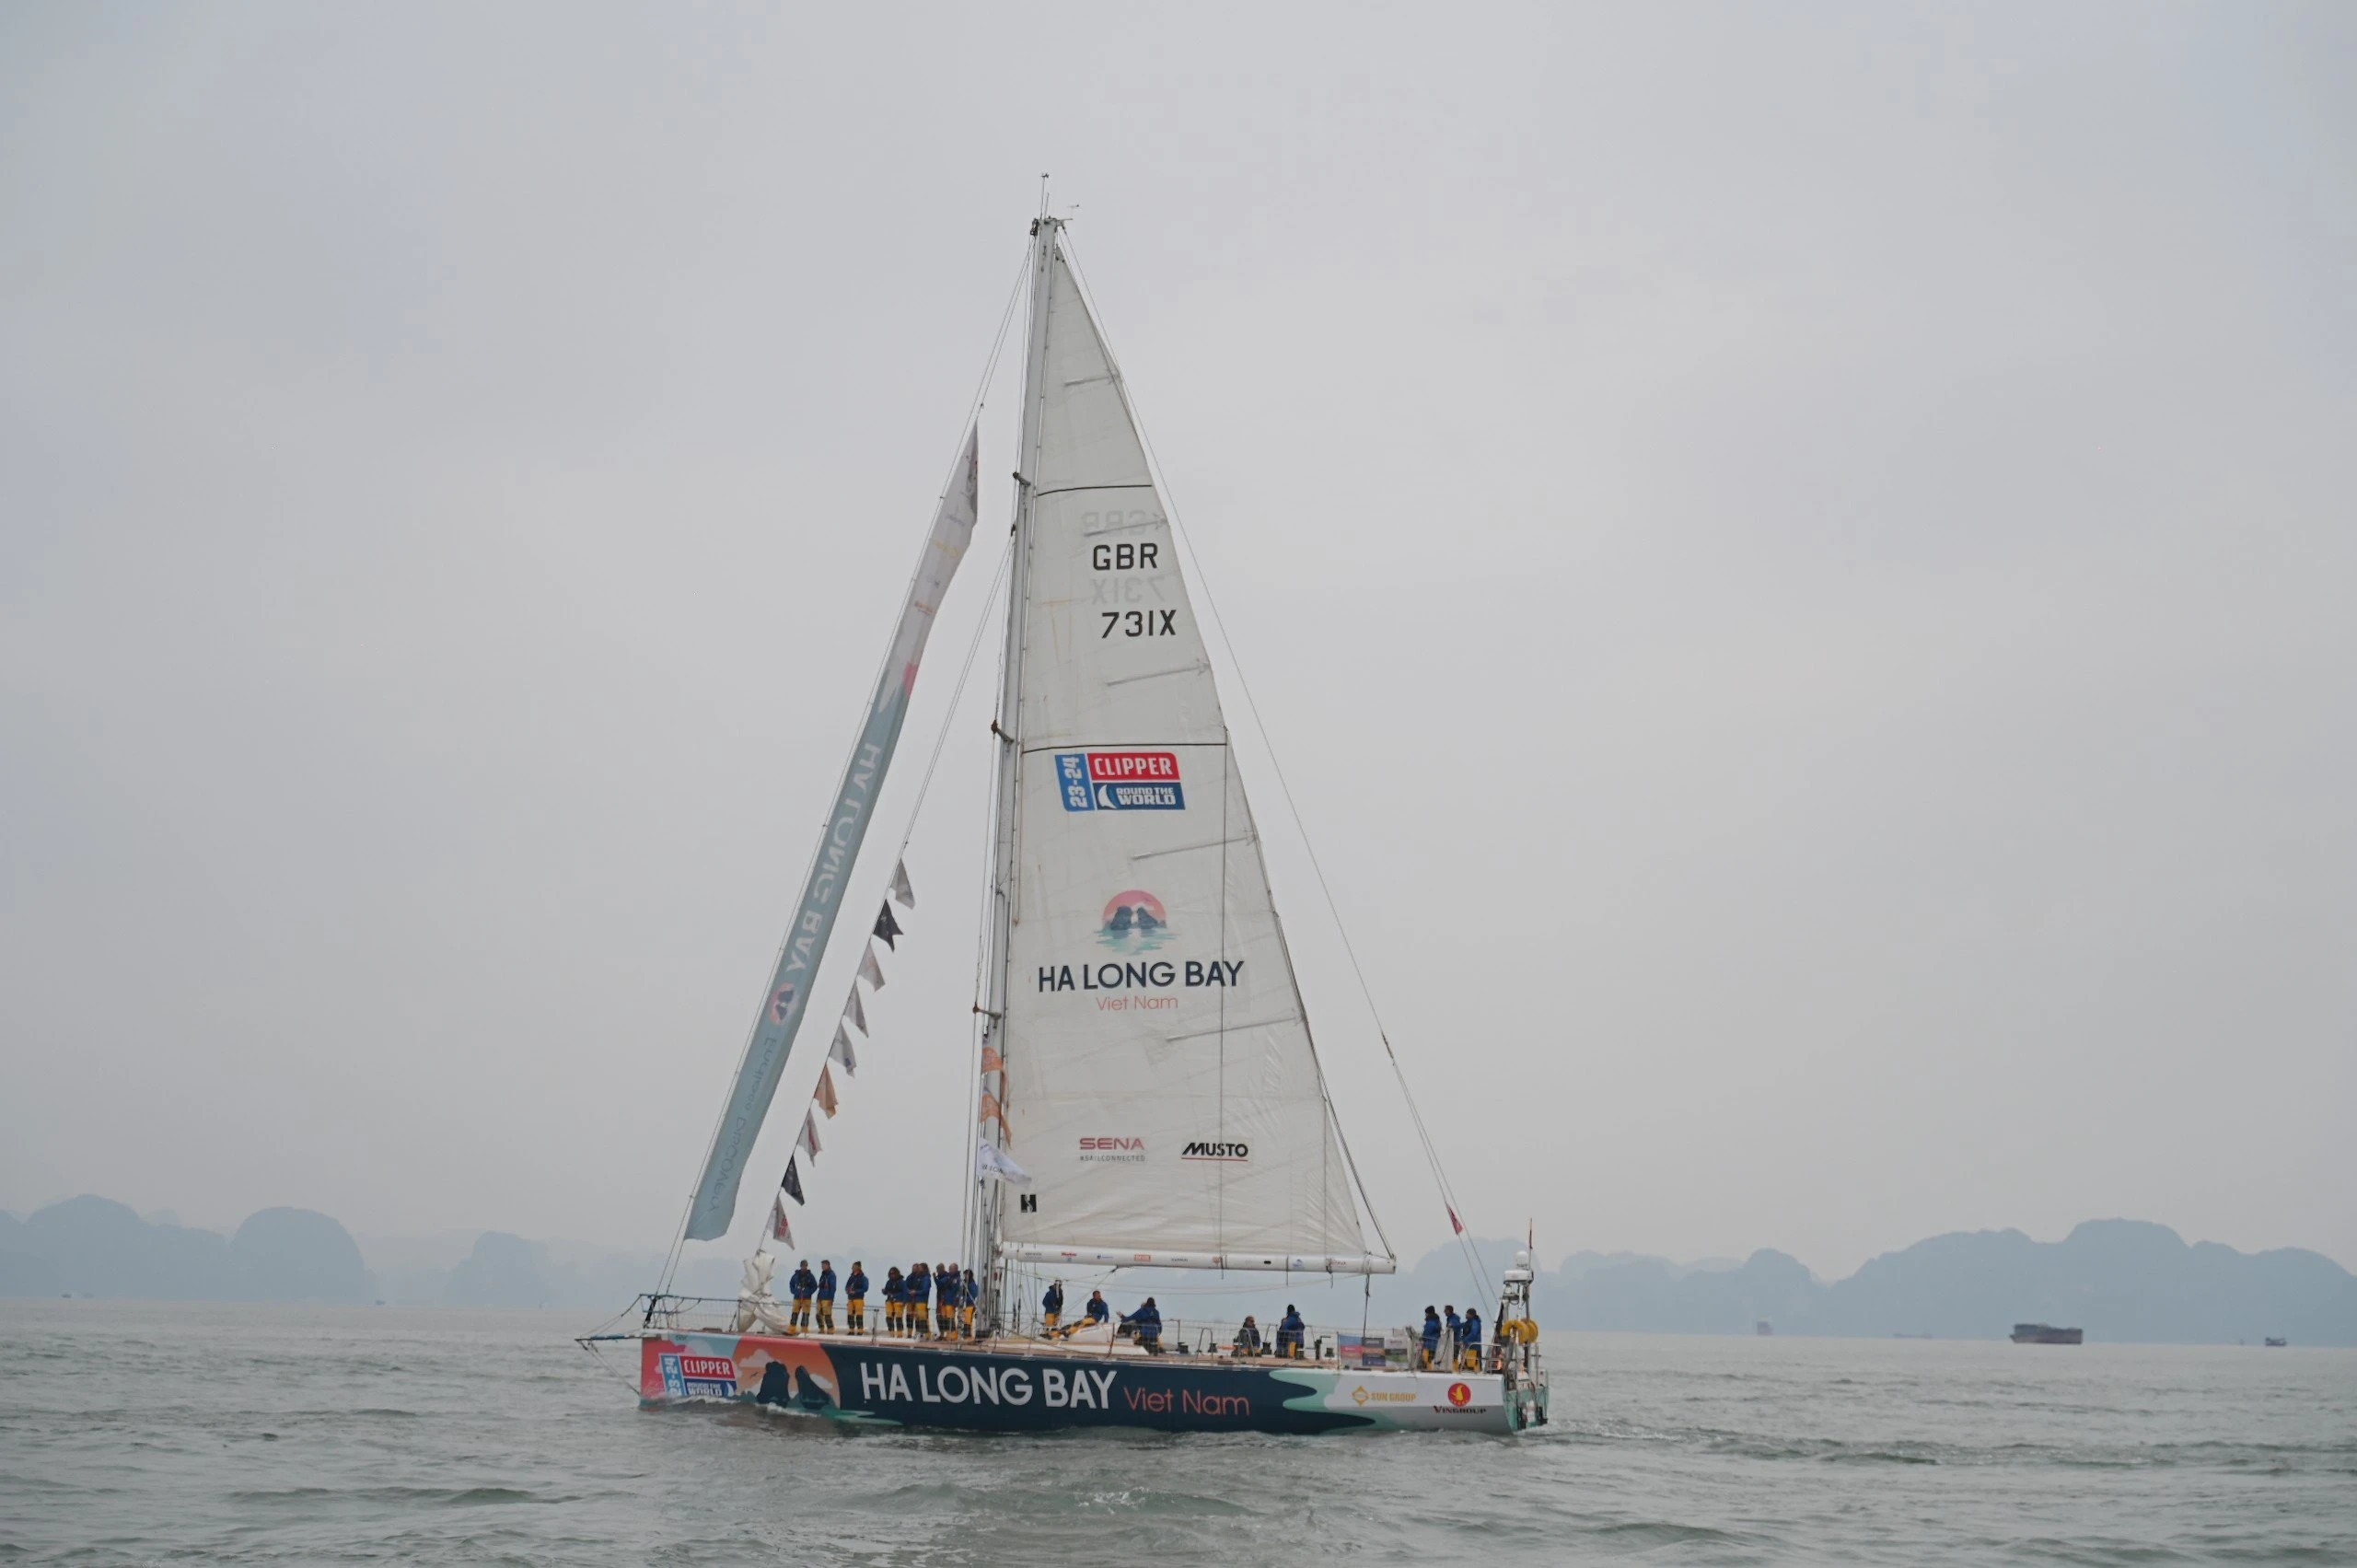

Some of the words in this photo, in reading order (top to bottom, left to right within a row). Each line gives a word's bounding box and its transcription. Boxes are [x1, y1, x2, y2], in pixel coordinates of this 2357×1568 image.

[1093, 543, 1158, 571] GBR
[1102, 609, 1177, 639] 731X
[1094, 757, 1174, 776] CLIPPER
[1062, 757, 1089, 808] 23-24
[1116, 787, 1153, 796] ROUND
[1117, 795, 1177, 806] WORLD
[1039, 965, 1075, 993] HA
[1083, 961, 1177, 990] LONG
[1185, 960, 1245, 988] BAY
[1096, 996, 1128, 1011] Viet
[1133, 994, 1178, 1010] Nam
[1079, 1137, 1145, 1151] SENA
[1182, 1143, 1248, 1158] MUSTO
[683, 1359, 731, 1376] CLIPPER
[860, 1362, 912, 1401] HA
[919, 1364, 1034, 1407] LONG
[1042, 1367, 1119, 1410] BAY
[1123, 1386, 1175, 1413] Viet
[1183, 1389, 1251, 1416] Nam
[1371, 1391, 1388, 1401] SUN
[1389, 1392, 1417, 1402] GROUP
